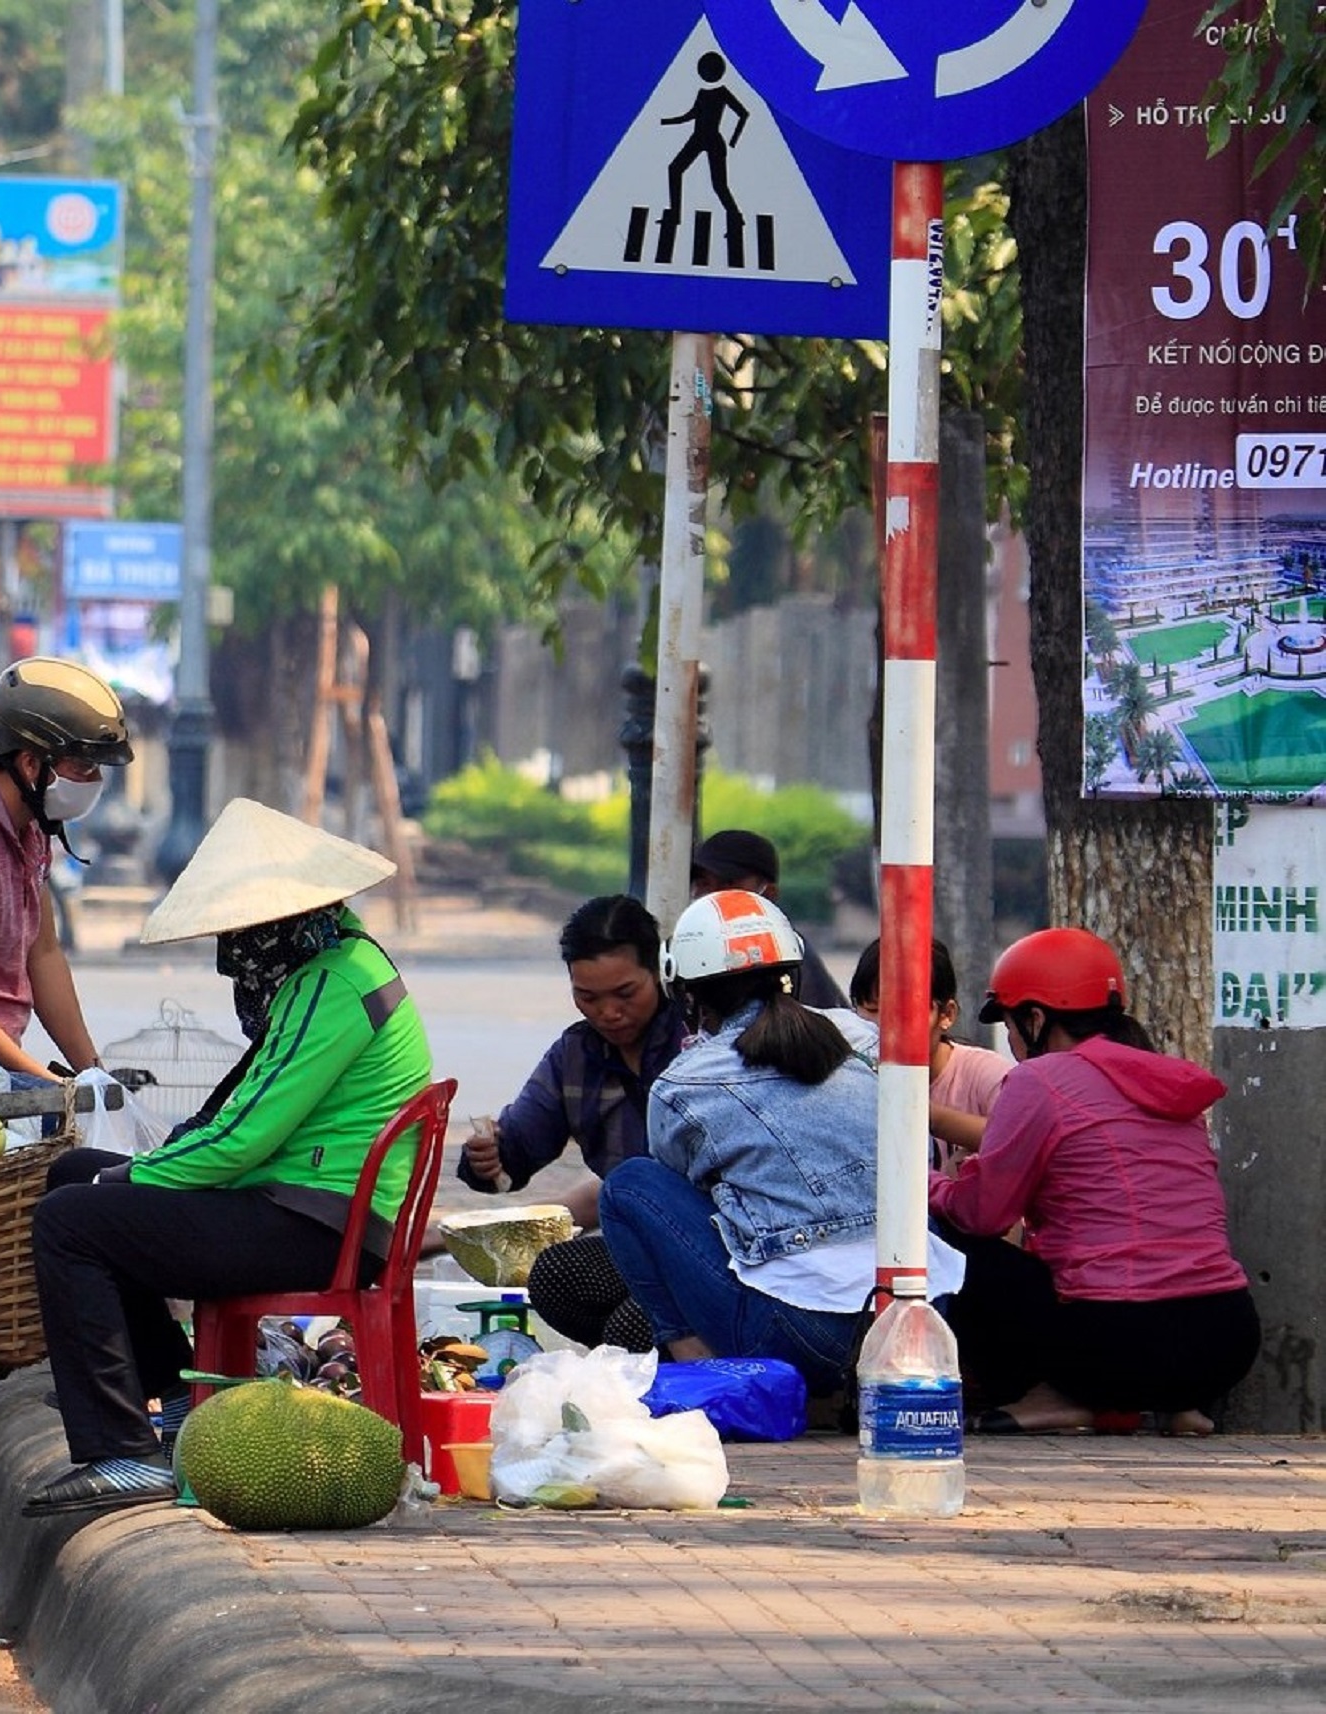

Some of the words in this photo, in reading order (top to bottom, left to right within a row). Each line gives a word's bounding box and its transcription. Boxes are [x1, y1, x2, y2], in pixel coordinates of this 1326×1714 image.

[1136, 98, 1169, 125] HỖ
[1148, 338, 1192, 364] KẾT
[1199, 338, 1236, 364] NỐI
[1240, 339, 1301, 368] CỘNG
[1308, 344, 1326, 364] Đ
[1135, 391, 1162, 414] Để
[1168, 396, 1215, 418] được
[1237, 393, 1268, 413] vấn
[1274, 396, 1301, 413] chi
[1129, 463, 1234, 488] Hotline
[1216, 886, 1318, 932] MINH
[895, 1409, 961, 1430] AQUAFINA
